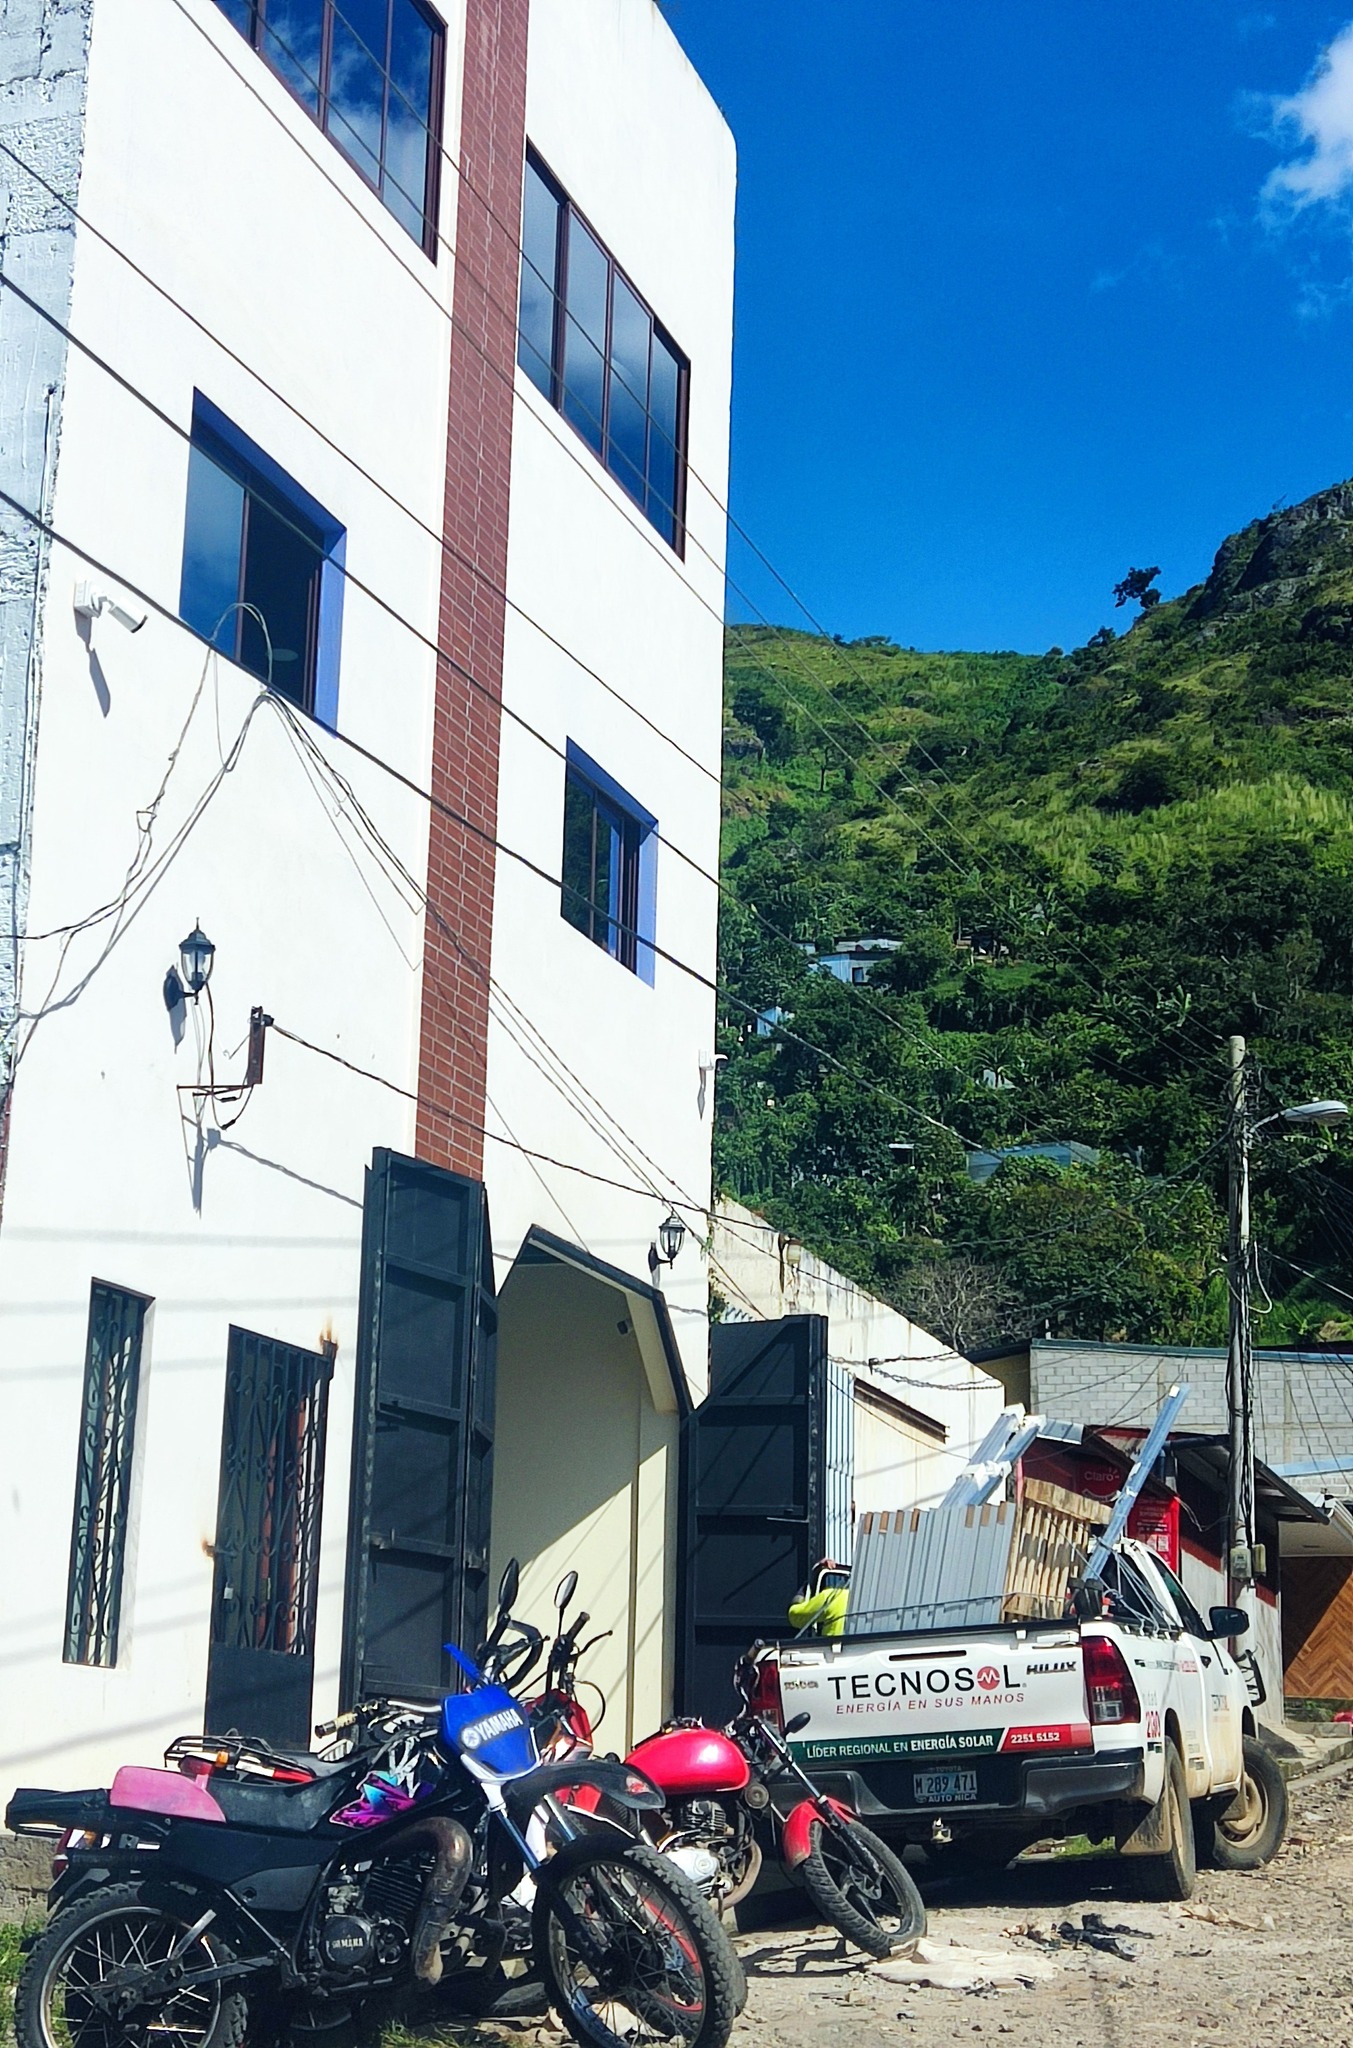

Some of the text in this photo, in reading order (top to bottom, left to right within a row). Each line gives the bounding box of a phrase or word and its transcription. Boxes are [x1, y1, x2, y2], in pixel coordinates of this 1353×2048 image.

[1084, 1470, 1113, 1482] Claro
[1026, 1661, 1077, 1675] HILUX
[836, 1692, 1025, 1714] ENERGÍA EN SUS MANOS
[473, 1708, 524, 1741] YAMAHA
[807, 1733, 994, 1758] LÍDER REGIONAL EN ENERGÍA SOLAR
[1010, 1732, 1060, 1744] 2251 5152
[915, 1774, 976, 1794] M 289 471
[928, 1793, 977, 1803] AUTO NICA
